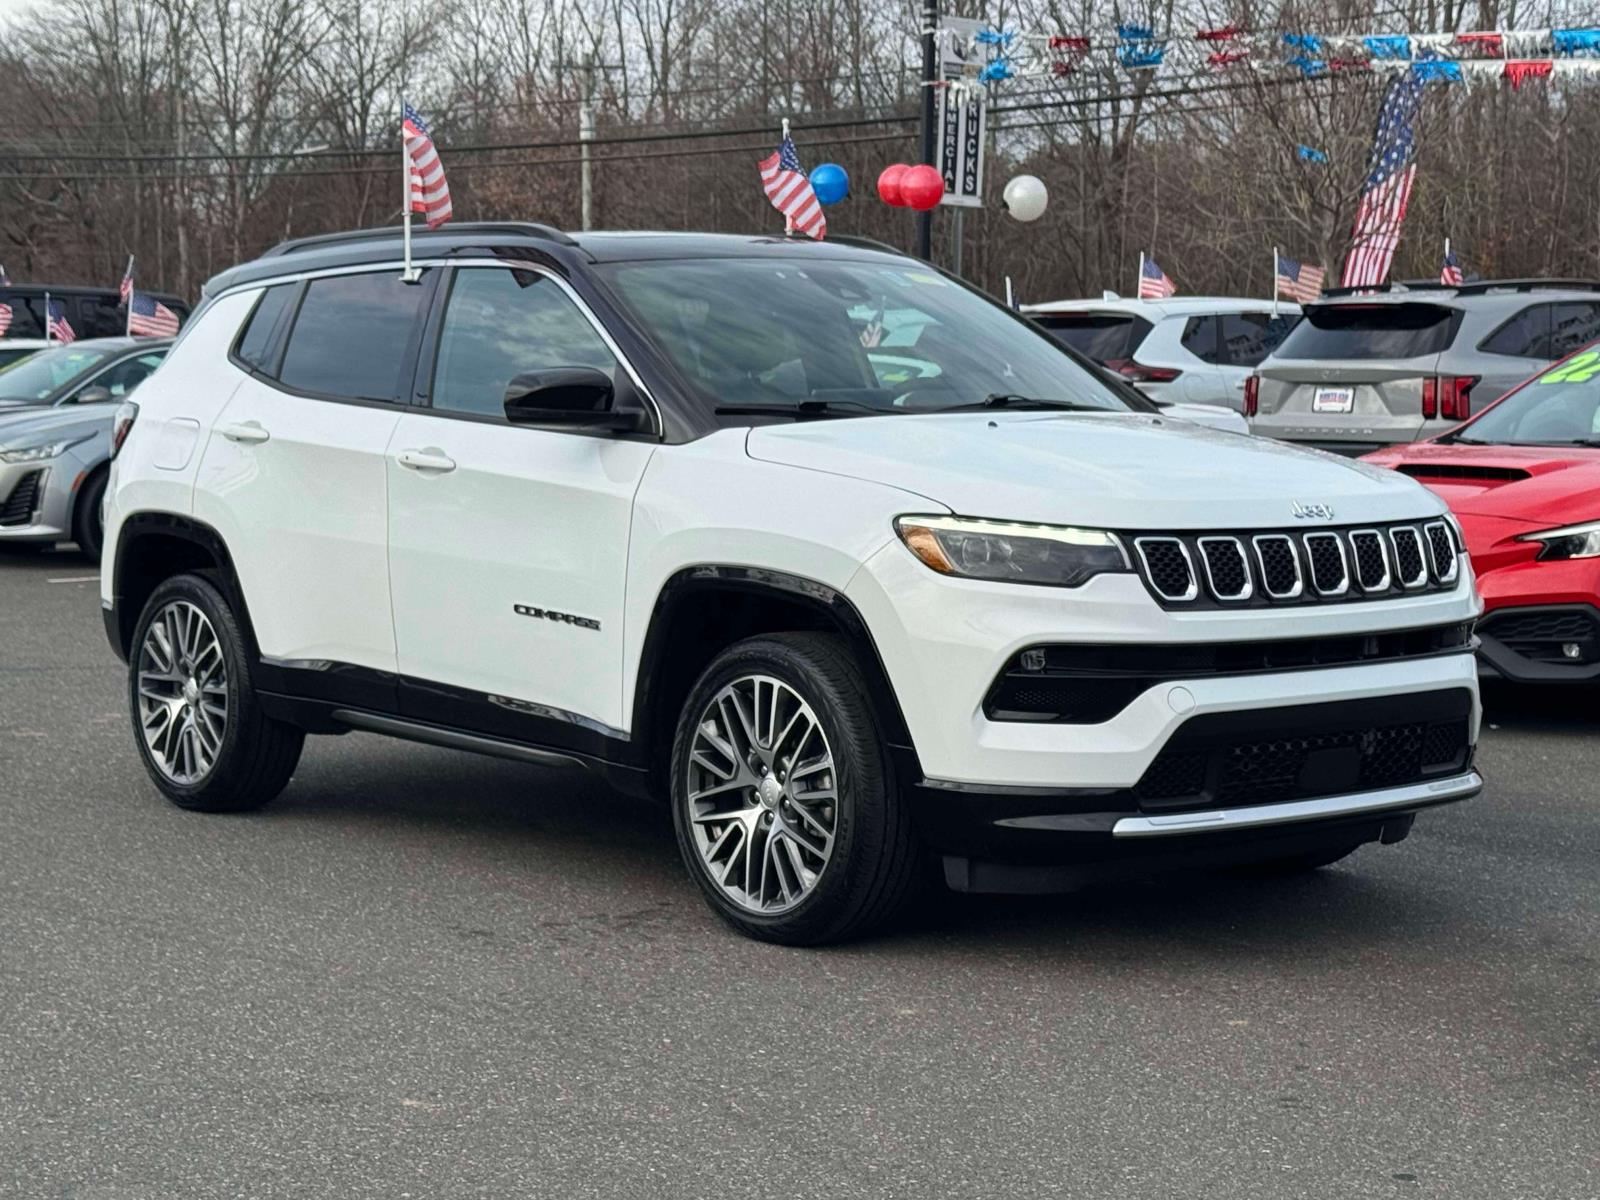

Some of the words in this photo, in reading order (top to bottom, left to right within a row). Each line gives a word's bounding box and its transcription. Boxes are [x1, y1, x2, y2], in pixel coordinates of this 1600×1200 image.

[944, 90, 957, 192] MERCIAL
[965, 99, 978, 192] RUCKS
[1291, 499, 1334, 521] Jeep
[513, 603, 601, 631] COMPASS
